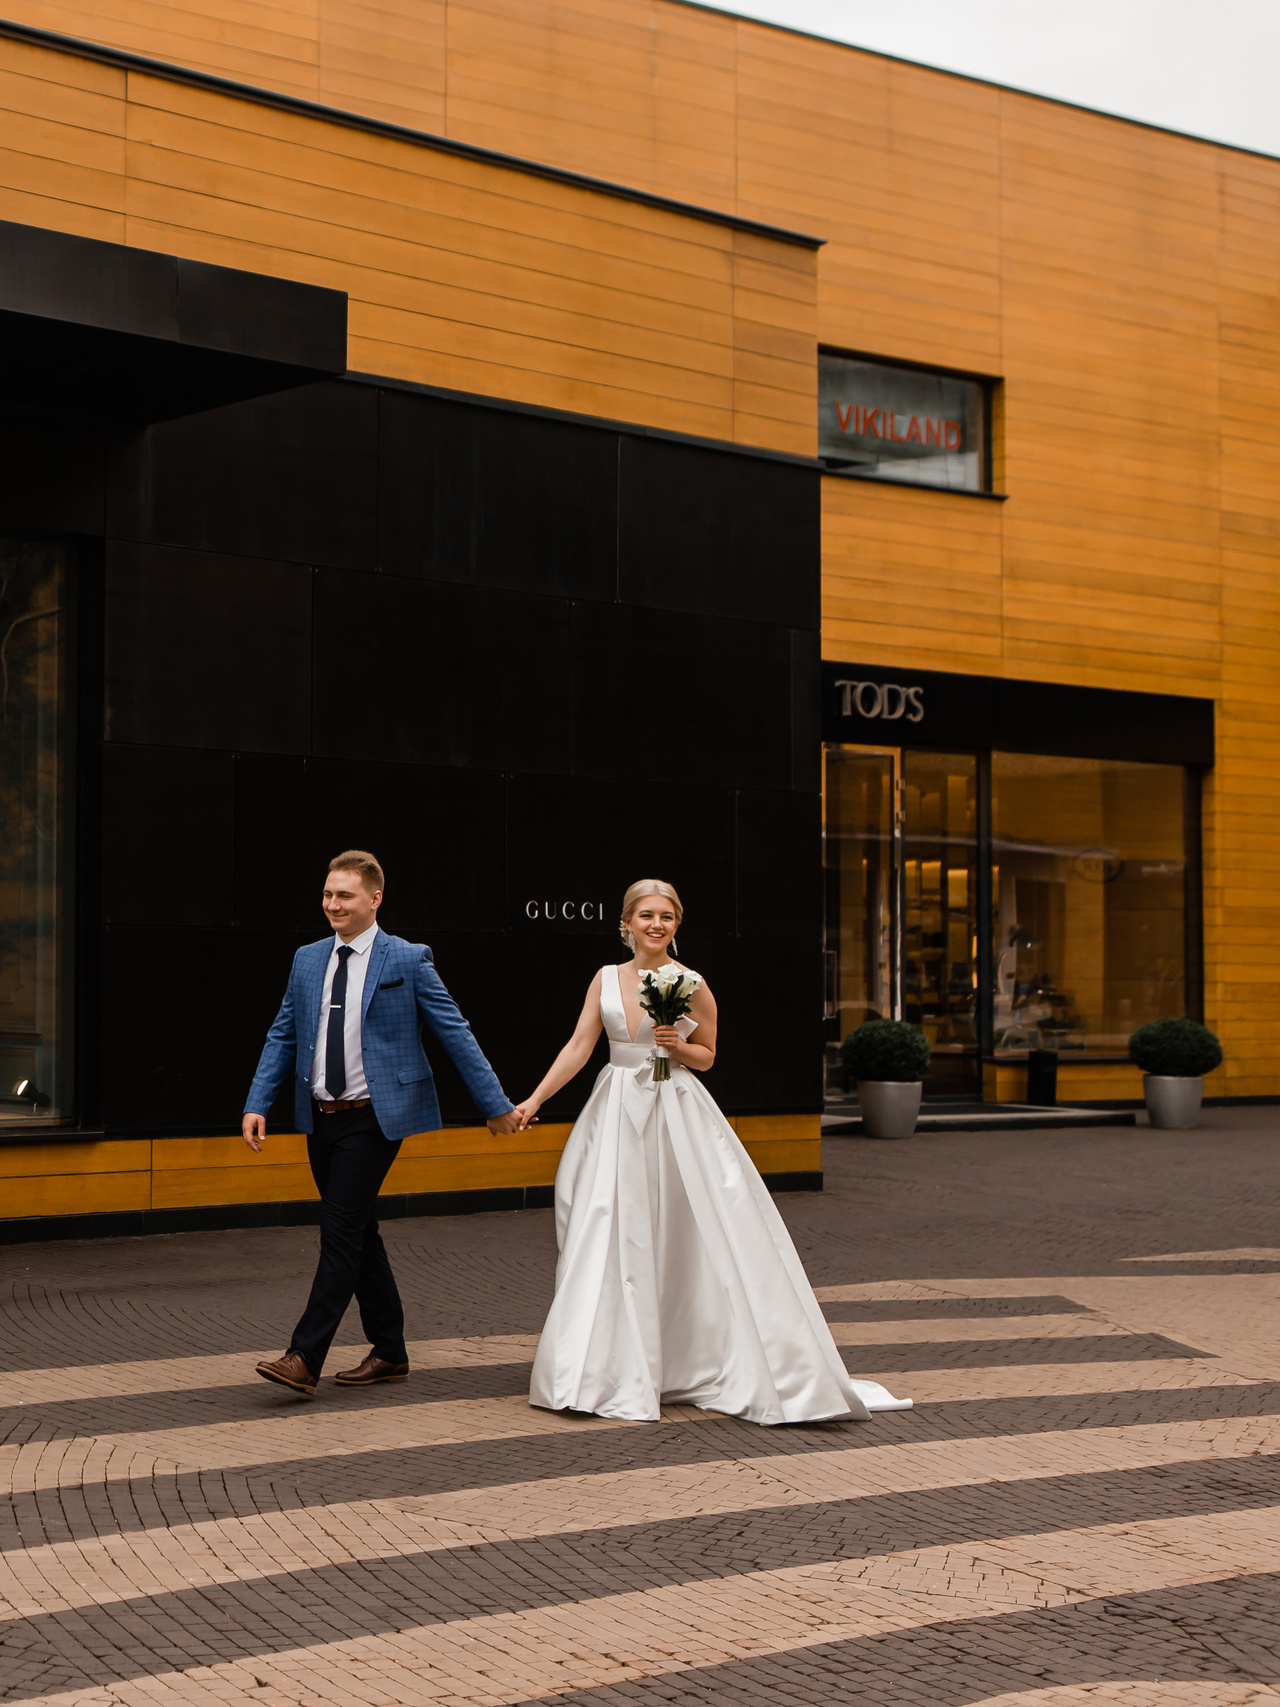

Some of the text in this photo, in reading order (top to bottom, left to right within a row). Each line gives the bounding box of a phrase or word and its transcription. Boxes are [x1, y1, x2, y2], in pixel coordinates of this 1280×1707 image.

[835, 400, 962, 450] VIKILAND
[834, 680, 925, 722] TOD'S
[525, 900, 603, 920] GUCCI
